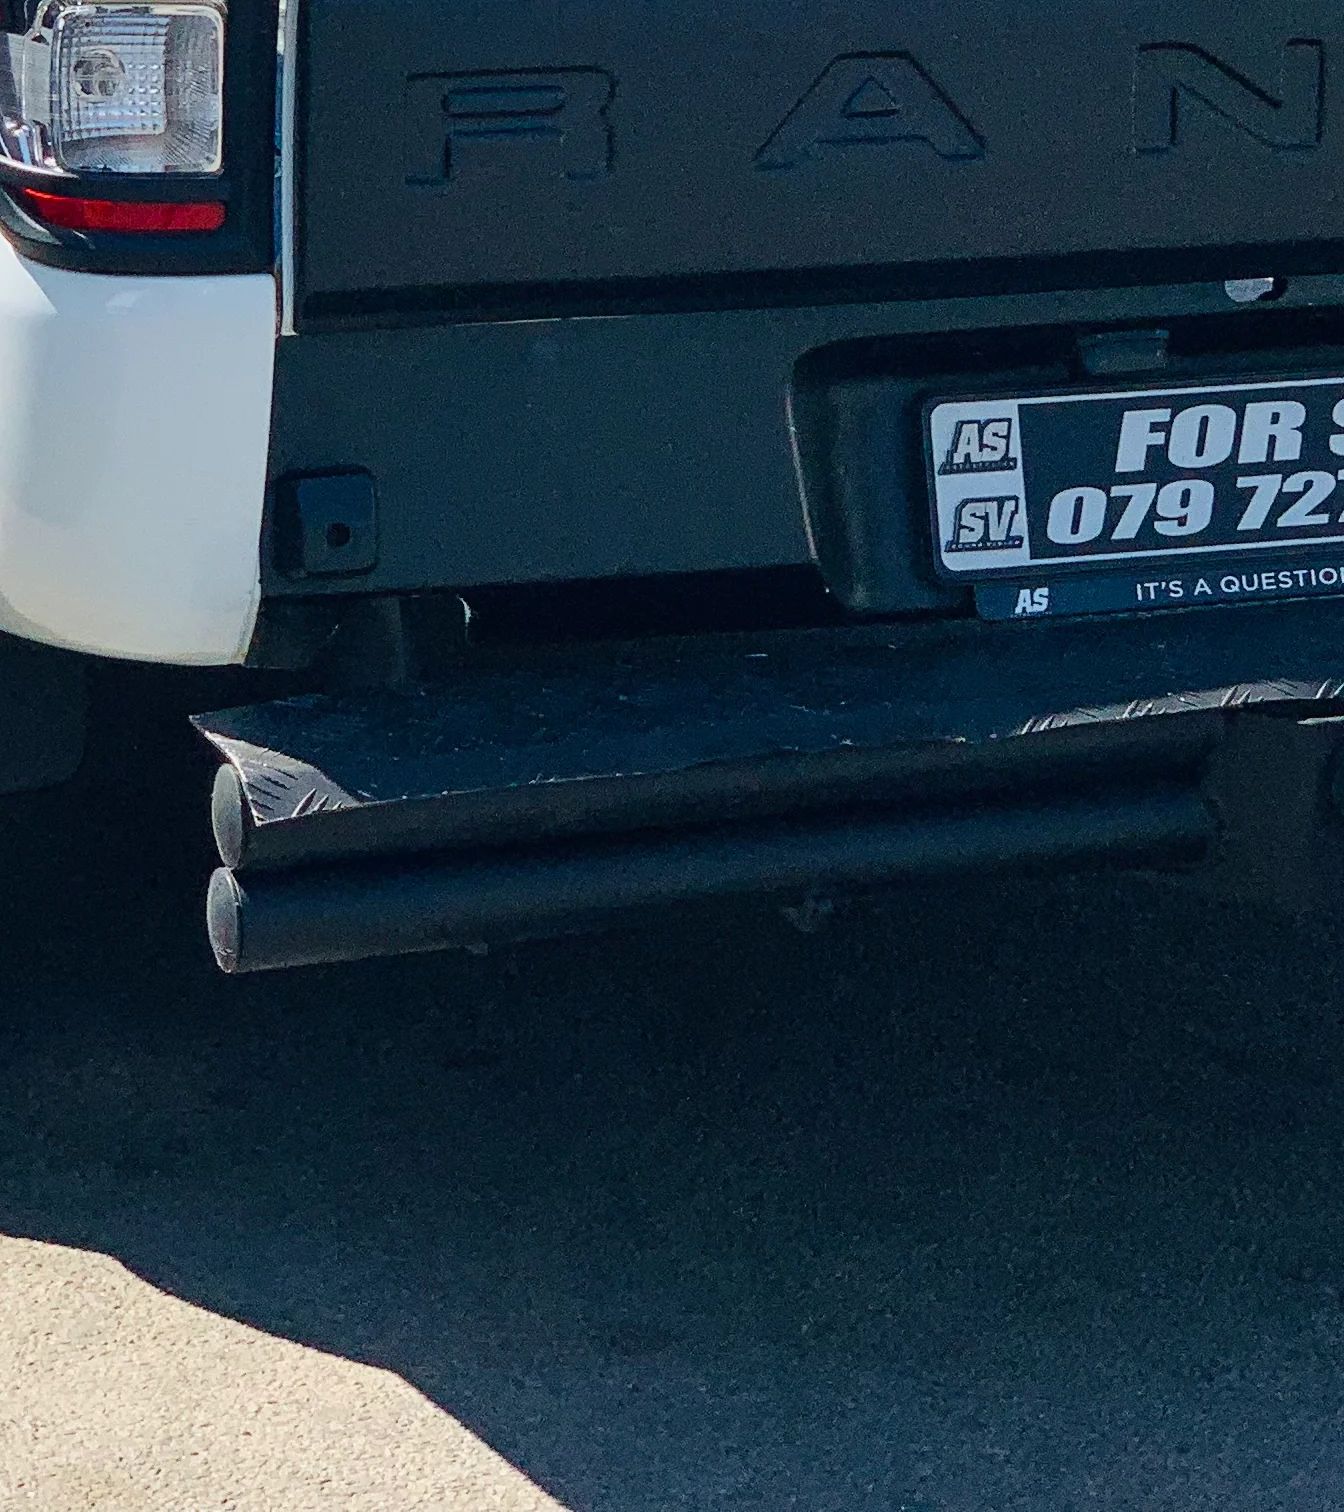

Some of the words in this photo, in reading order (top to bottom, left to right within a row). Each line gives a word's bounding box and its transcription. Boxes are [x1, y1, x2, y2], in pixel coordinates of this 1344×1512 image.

[950, 419, 1011, 465] AS
[1115, 400, 1307, 473] FOR
[958, 498, 1017, 545] SV
[1046, 479, 1215, 545] 079
[1014, 587, 1049, 616] AS
[1136, 579, 1184, 602] IT'S
[1193, 577, 1213, 596] A
